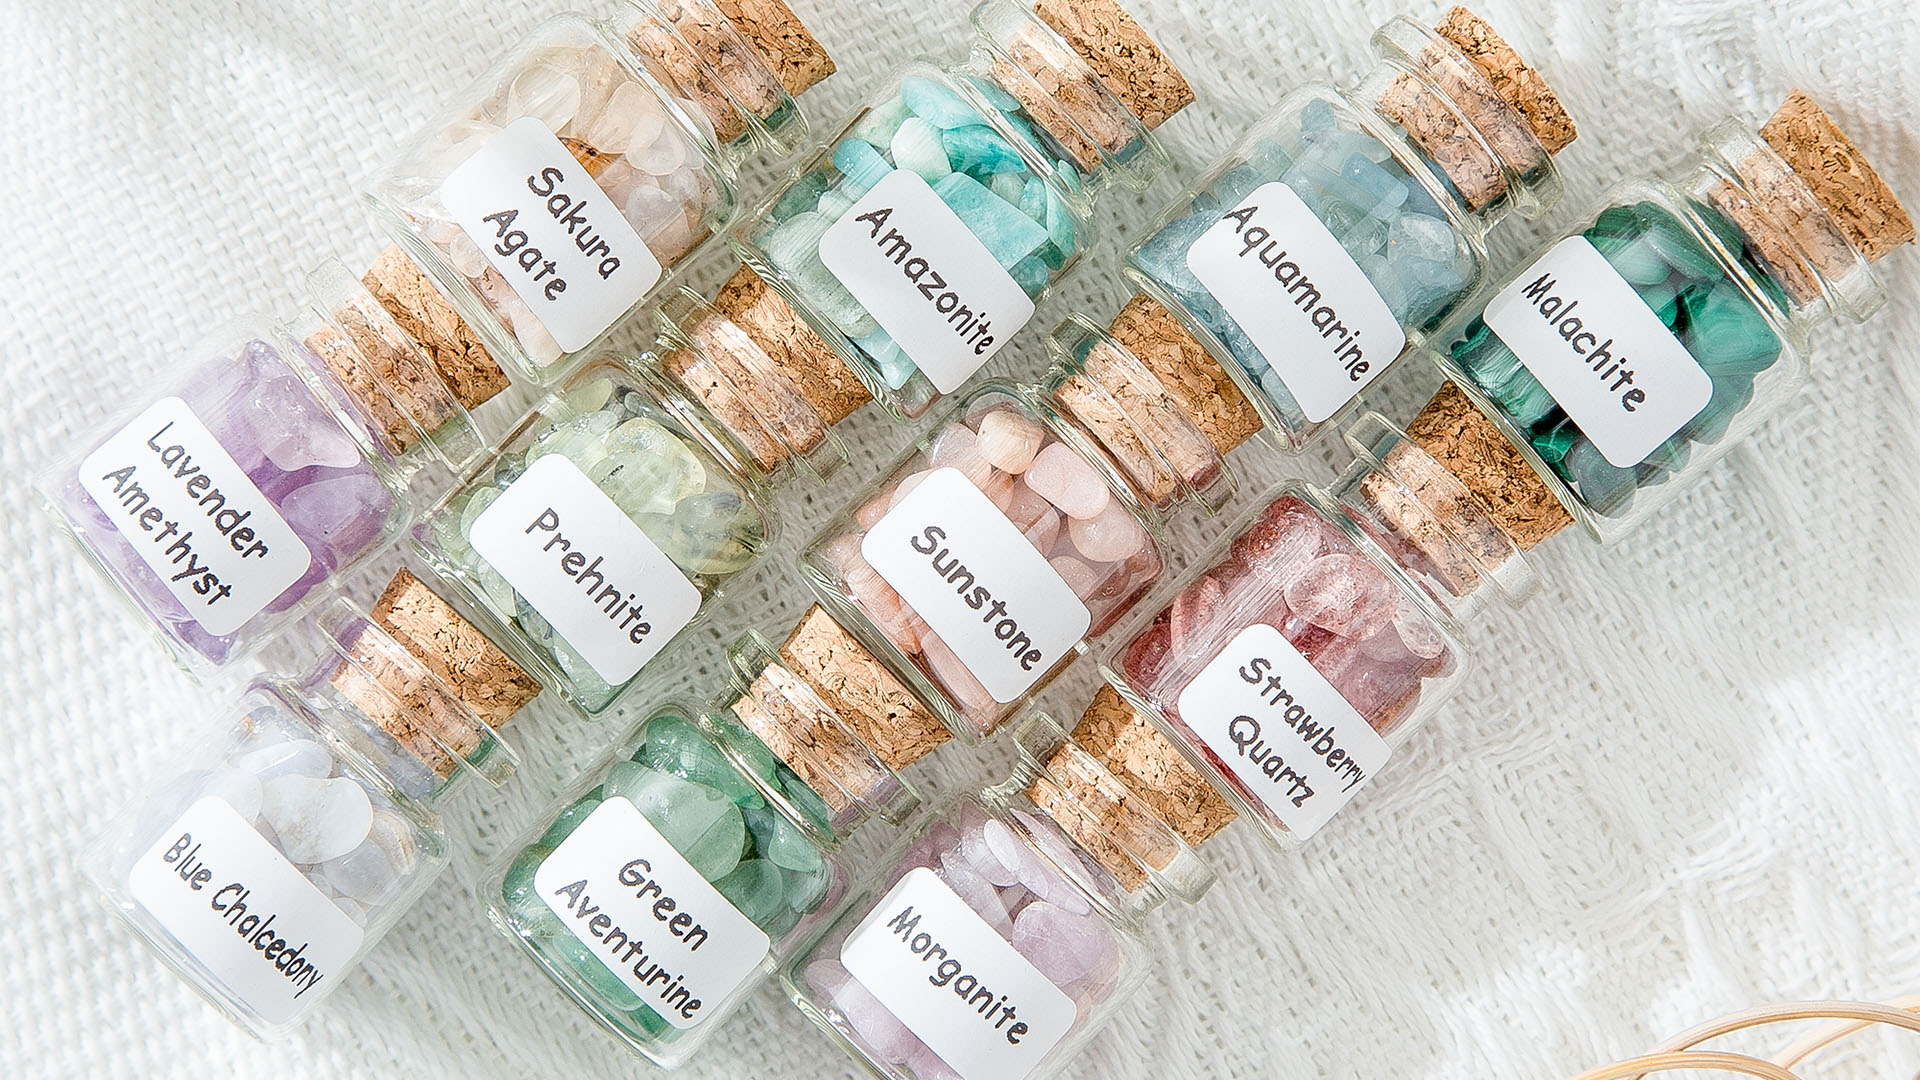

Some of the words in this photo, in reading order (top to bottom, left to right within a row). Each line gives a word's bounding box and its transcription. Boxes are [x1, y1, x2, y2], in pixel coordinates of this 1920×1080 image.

[483, 208, 569, 302] Agate
[527, 166, 621, 281] Sakura
[854, 206, 1003, 357] Amazonite
[1223, 204, 1375, 384] Aquamarine
[1521, 273, 1647, 413] Malachite
[102, 464, 234, 609] Amethyst
[146, 421, 268, 564] Lavender
[524, 507, 653, 645] Prehnite
[910, 526, 1043, 672] Sunstone
[1228, 715, 1315, 808] Quartz
[1238, 657, 1367, 793] Strawberry
[162, 833, 212, 891] Blue
[211, 883, 325, 1001] Chalcedony
[554, 880, 704, 1021] Aventurine
[618, 859, 709, 951] Green
[887, 905, 1029, 1045] Morganite
